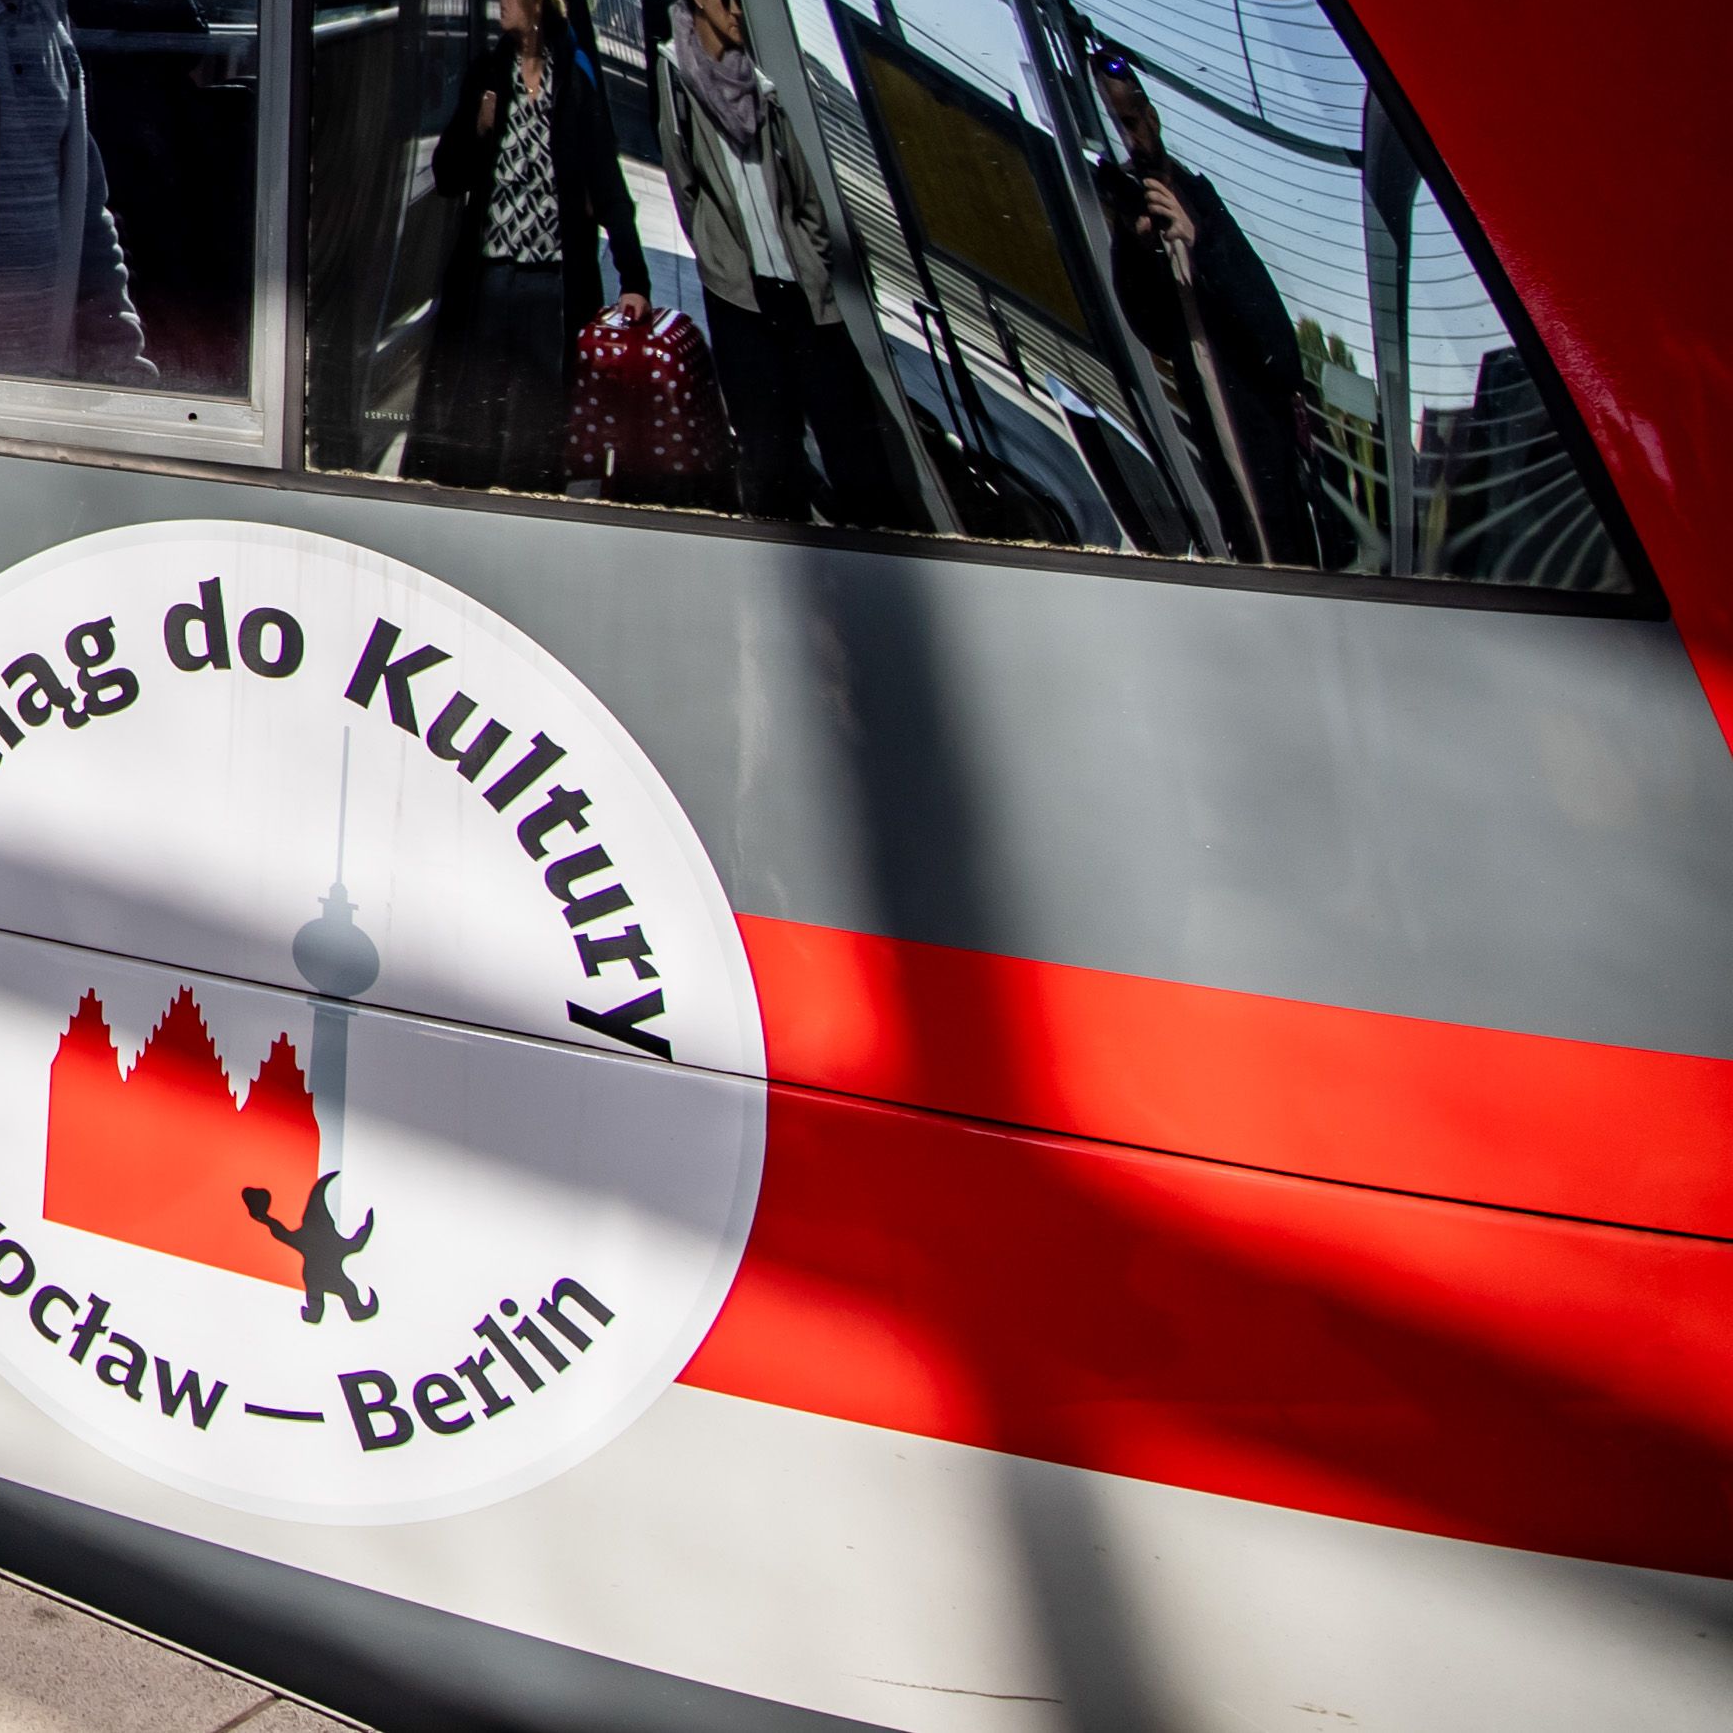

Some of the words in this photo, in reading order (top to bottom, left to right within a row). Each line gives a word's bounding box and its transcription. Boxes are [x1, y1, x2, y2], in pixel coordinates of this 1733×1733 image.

[164, 576, 304, 678] do
[344, 617, 674, 1061] Kultury
[337, 1273, 616, 1452] Berlin
